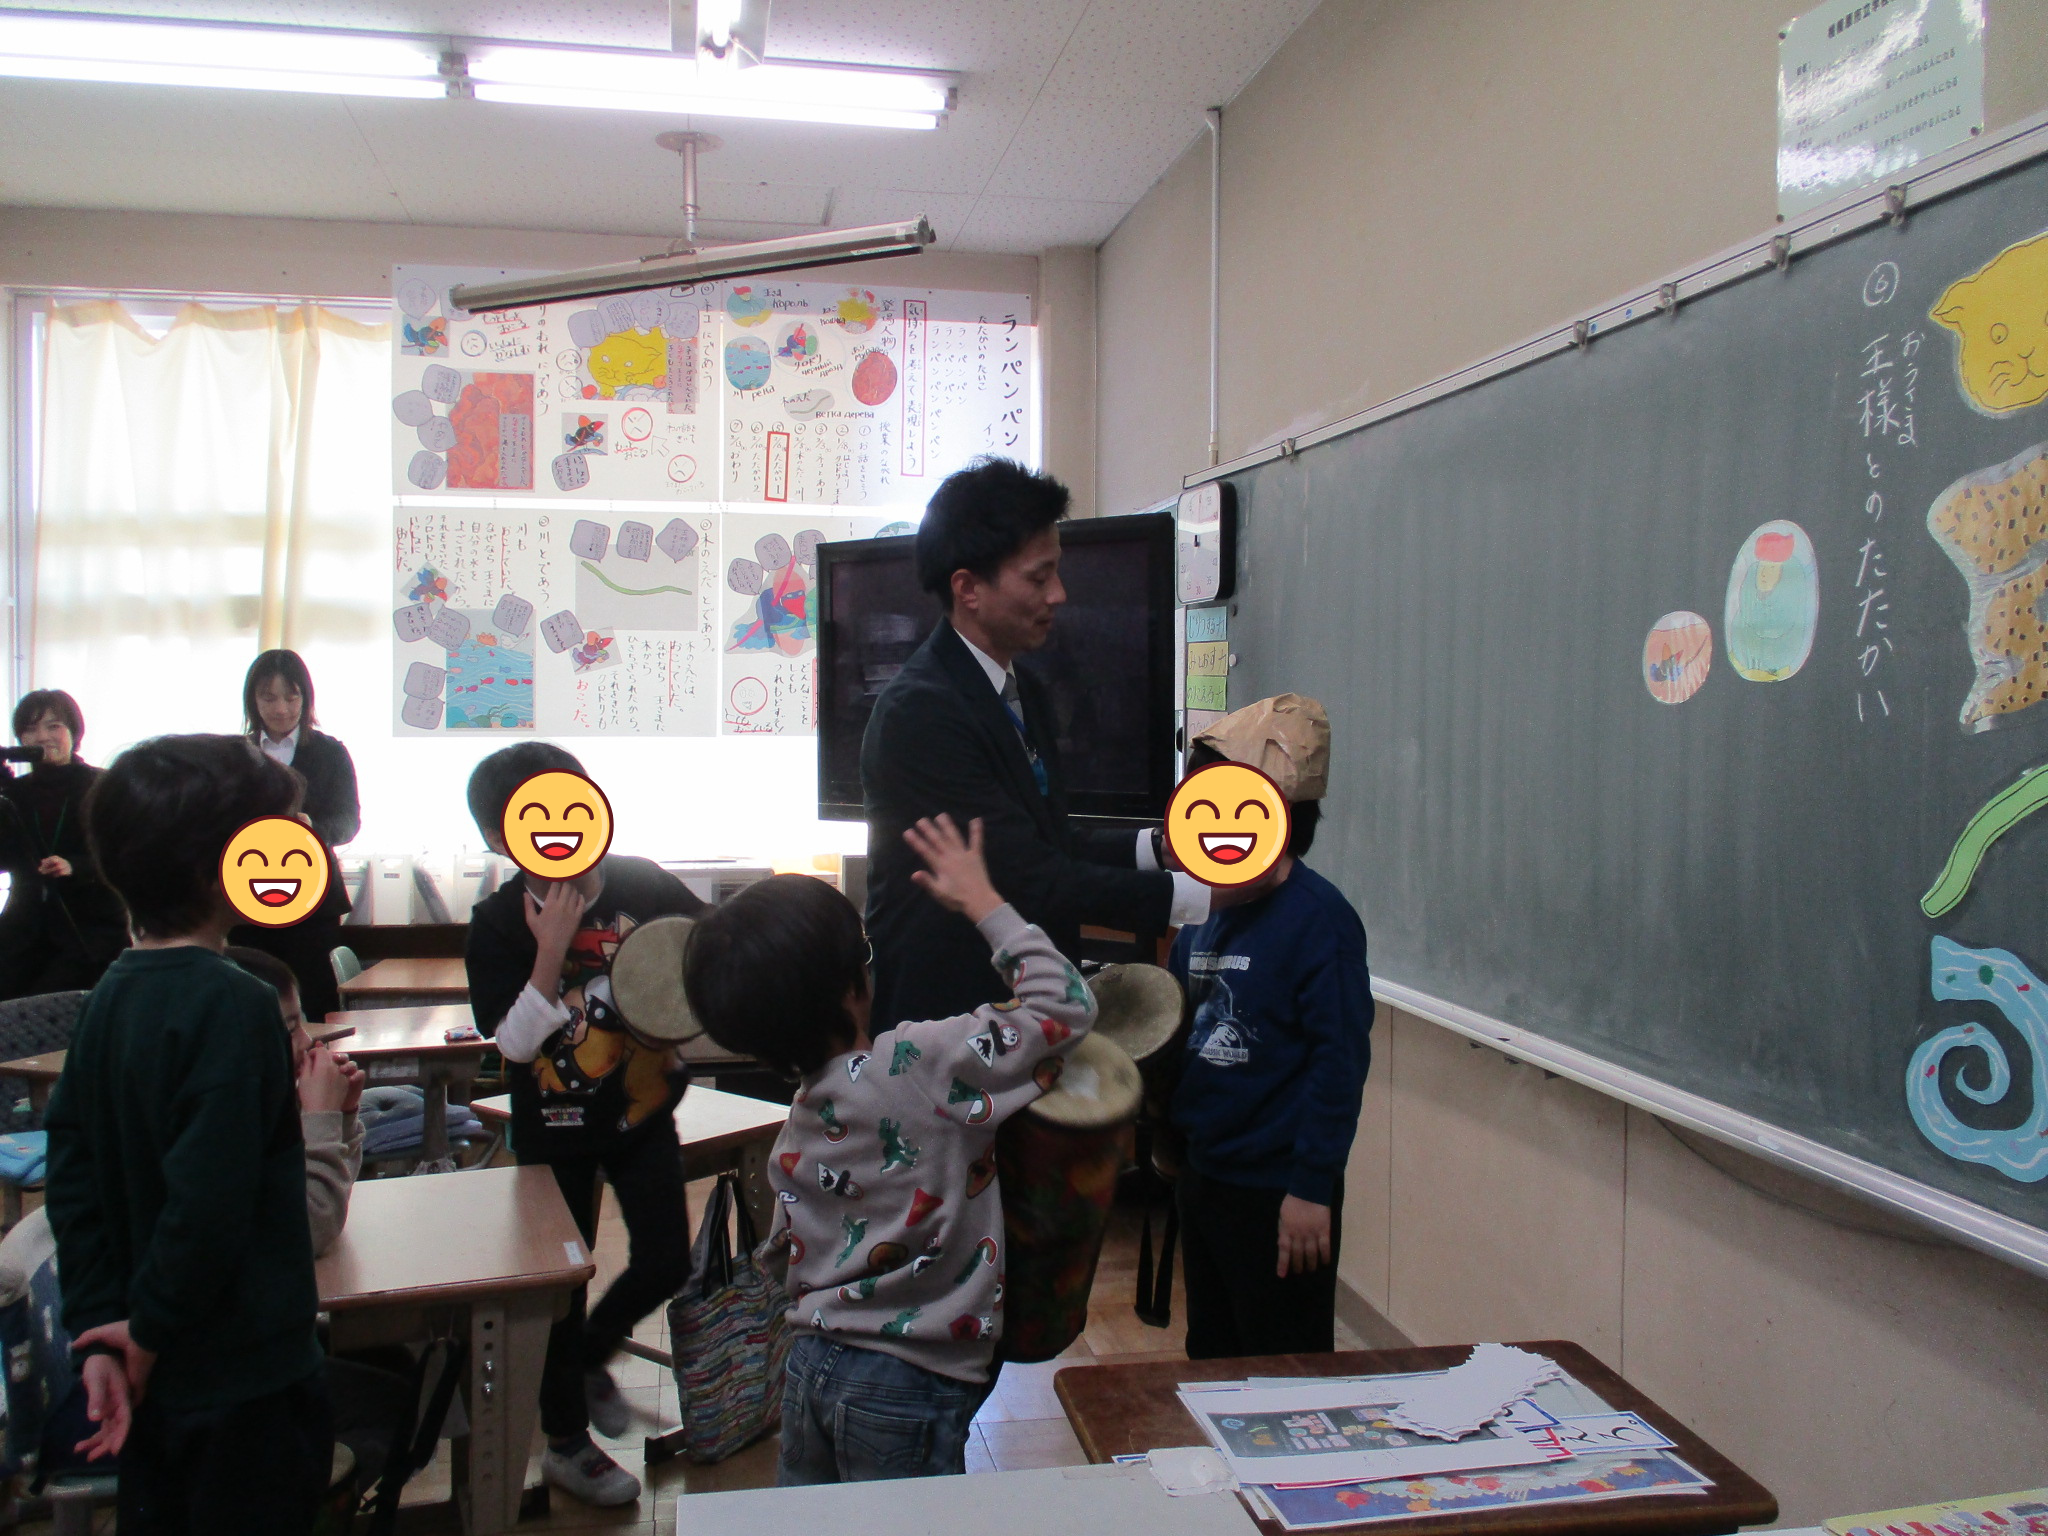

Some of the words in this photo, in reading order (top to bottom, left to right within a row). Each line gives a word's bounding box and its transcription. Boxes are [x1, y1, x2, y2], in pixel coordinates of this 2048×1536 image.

[880, 299, 897, 350] 登場人物
[944, 325, 956, 406] ランパンパン
[957, 326, 969, 406] ランパンパン
[929, 325, 943, 461] ランパンパンパンパン
[1001, 313, 1023, 446] ランパンパン
[1857, 333, 1900, 724] 王様とのたたかい
